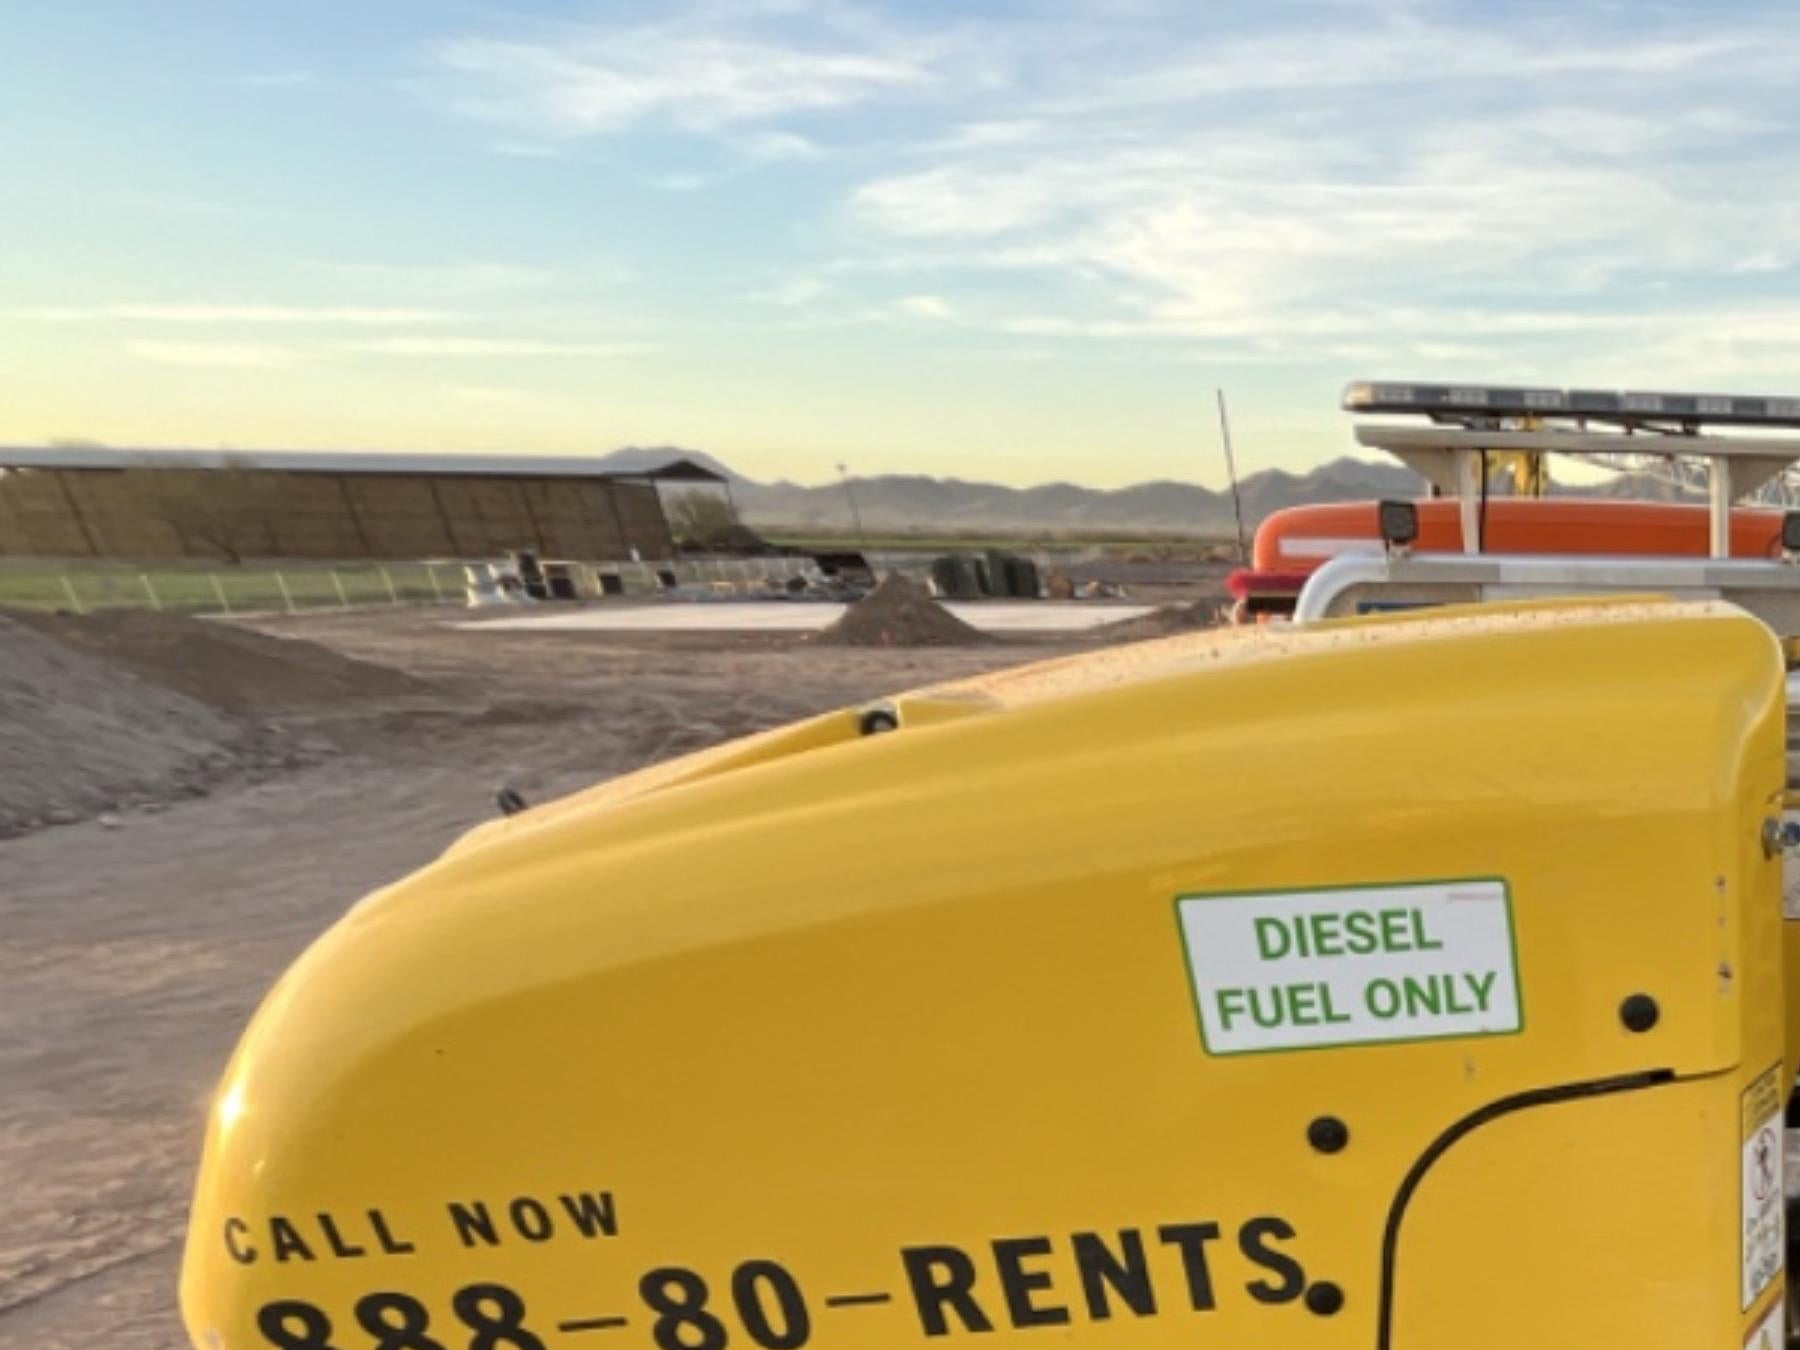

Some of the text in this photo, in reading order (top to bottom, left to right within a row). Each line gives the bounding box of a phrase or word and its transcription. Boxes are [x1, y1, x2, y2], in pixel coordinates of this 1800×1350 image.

[1253, 907, 1443, 961] DIESEL
[1216, 970, 1497, 1032] FUEL ONLY
[223, 1190, 619, 1264] CALL NOW
